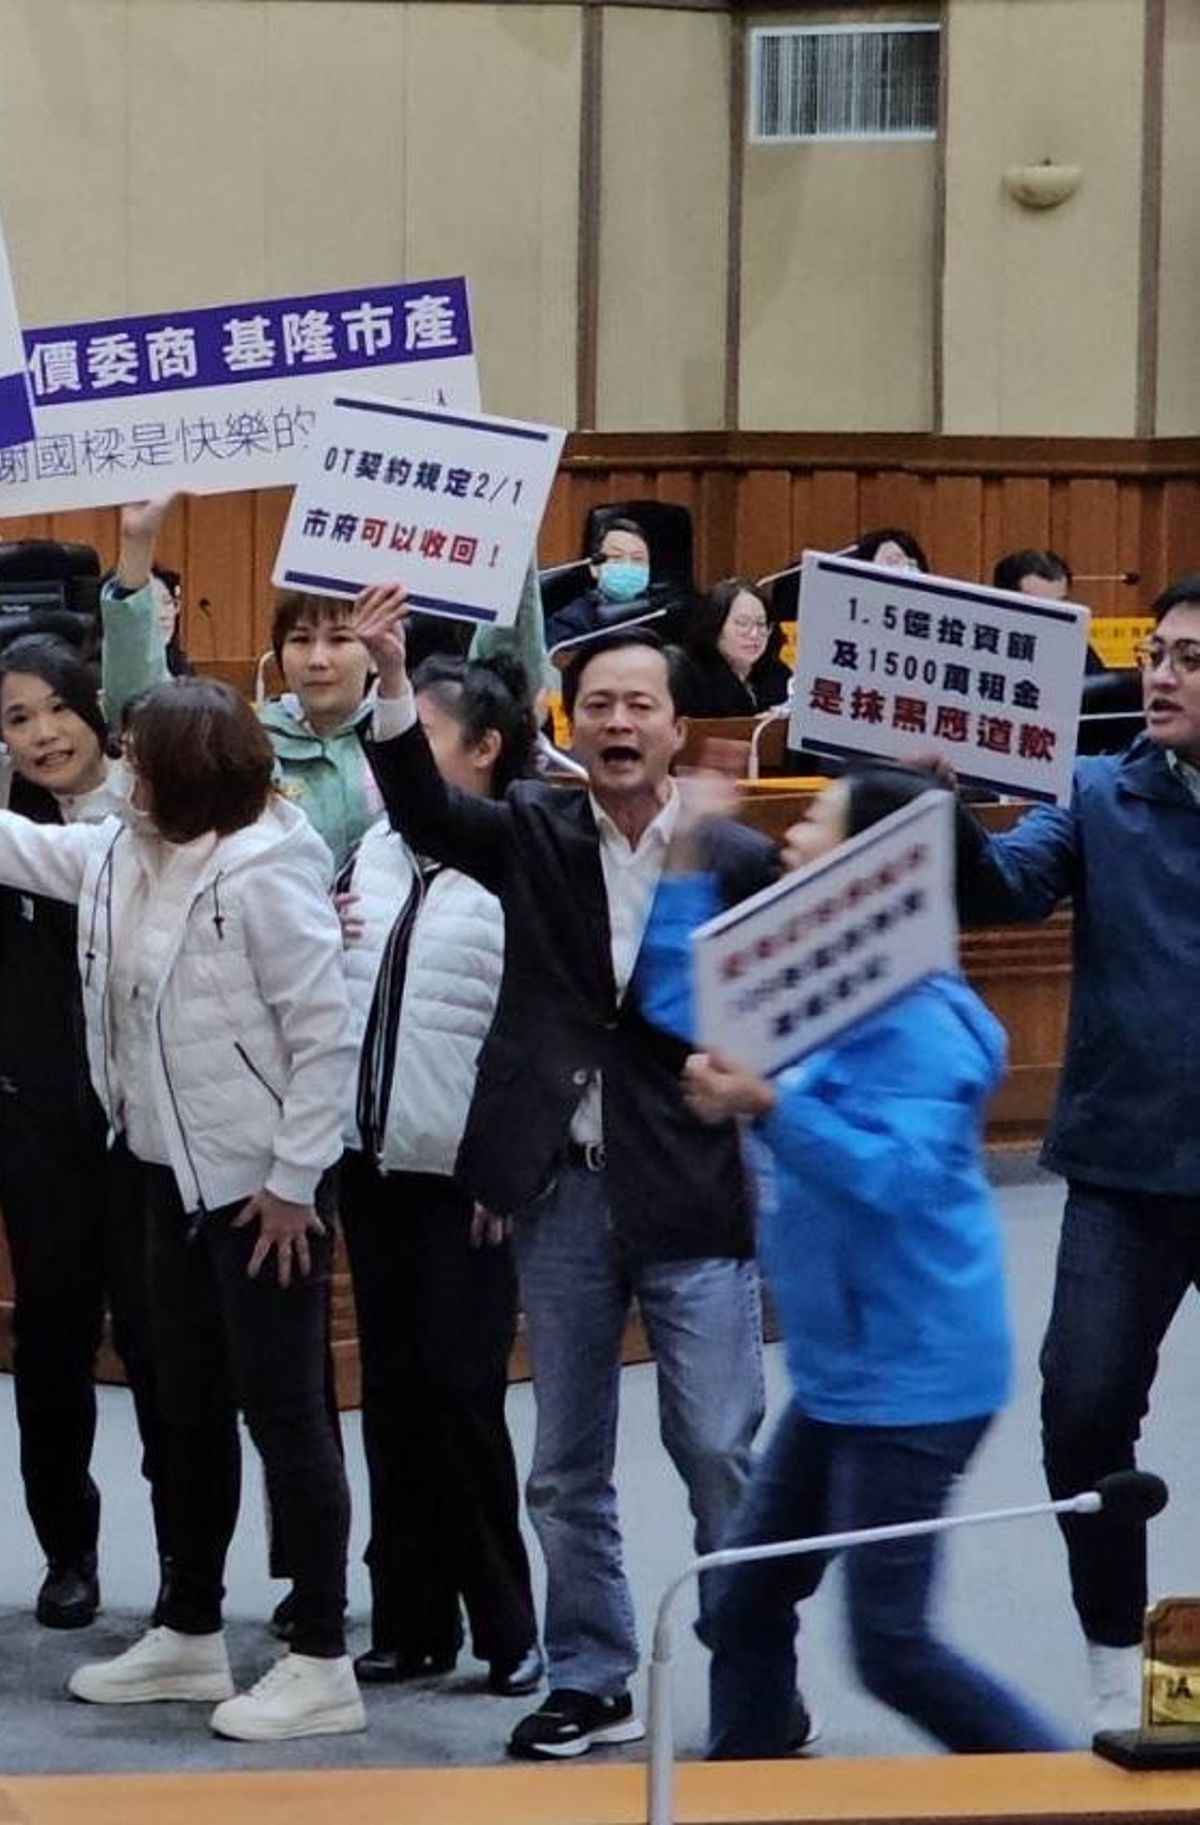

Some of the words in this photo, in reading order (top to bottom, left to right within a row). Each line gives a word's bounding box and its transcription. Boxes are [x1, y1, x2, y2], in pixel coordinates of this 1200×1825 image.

[223, 293, 458, 373] 基隆市產
[323, 447, 524, 506] OT契約規定2/1
[302, 508, 502, 570] 市府可以收回！
[831, 638, 1041, 712] 及1500萬租金
